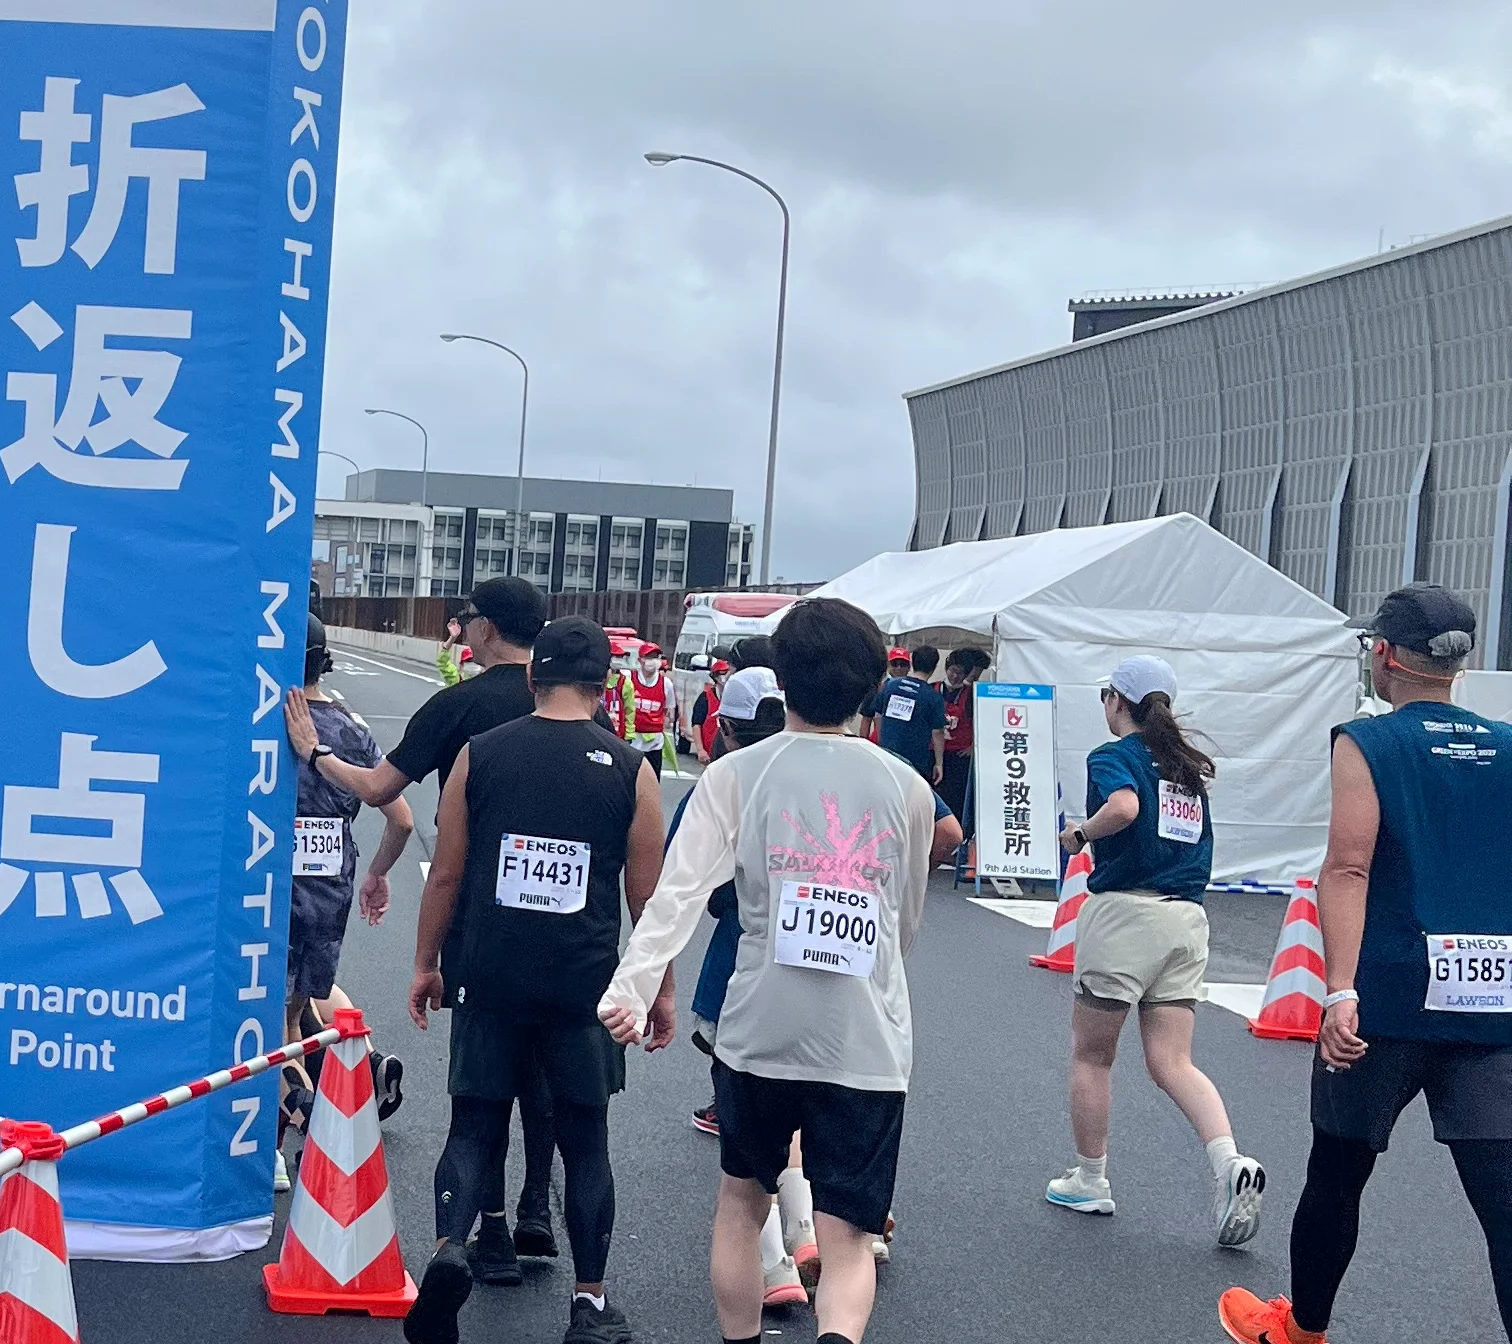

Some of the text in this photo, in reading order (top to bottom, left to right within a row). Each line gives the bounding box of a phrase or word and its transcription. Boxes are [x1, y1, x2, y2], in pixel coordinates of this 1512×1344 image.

[1002, 731, 1032, 857] 第9救護所
[1161, 795, 1202, 823] H33060
[304, 821, 335, 830] ENEOS
[526, 840, 577, 857] ENEOS
[229, 580, 290, 1156] MARATHON
[503, 855, 584, 887] F14431
[984, 863, 1052, 876] 9th Aid Station
[519, 892, 551, 906] PUMA
[812, 887, 869, 909] ENEOS
[781, 906, 877, 946] J19000
[1456, 939, 1508, 950] ENEOS
[803, 947, 839, 966] PUMA
[1446, 995, 1505, 1006] LAWSON
[9, 1029, 116, 1072] Point
